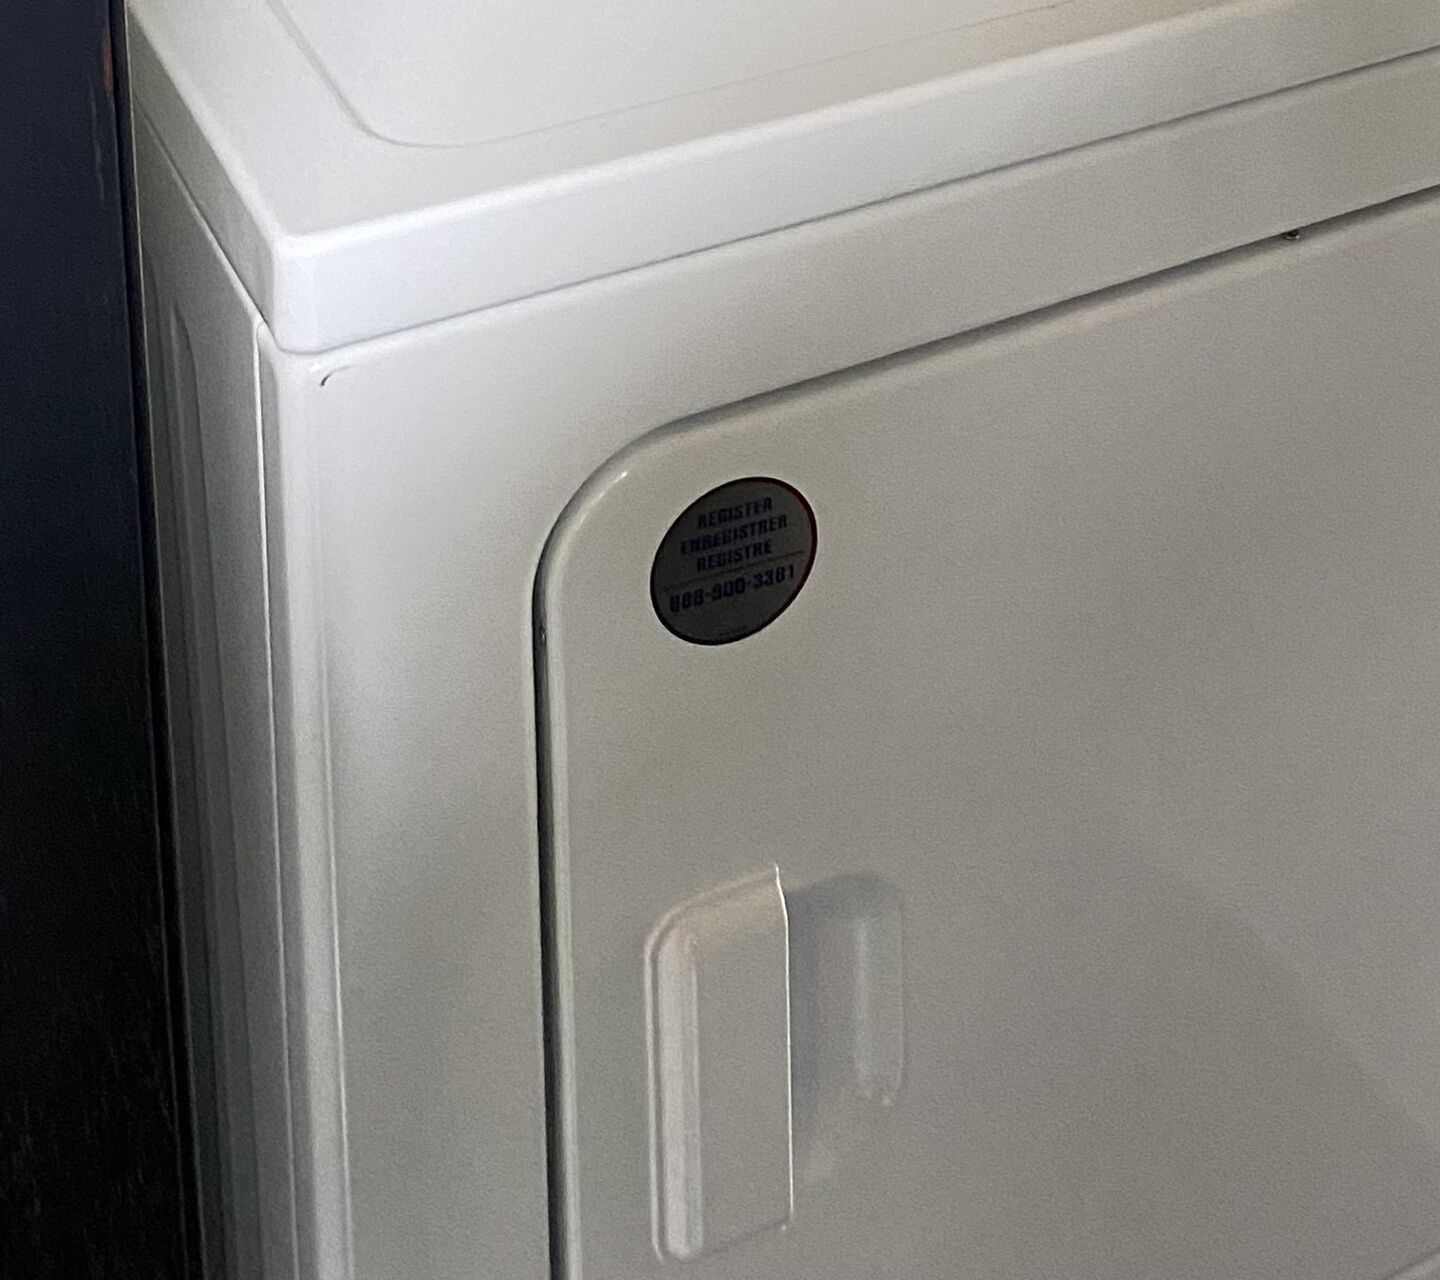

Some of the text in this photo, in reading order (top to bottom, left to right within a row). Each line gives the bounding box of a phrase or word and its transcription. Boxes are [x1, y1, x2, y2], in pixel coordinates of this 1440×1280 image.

[697, 496, 773, 530] REGISTER
[680, 514, 788, 555] ENREGISTRER
[696, 540, 773, 572] REGISTRE
